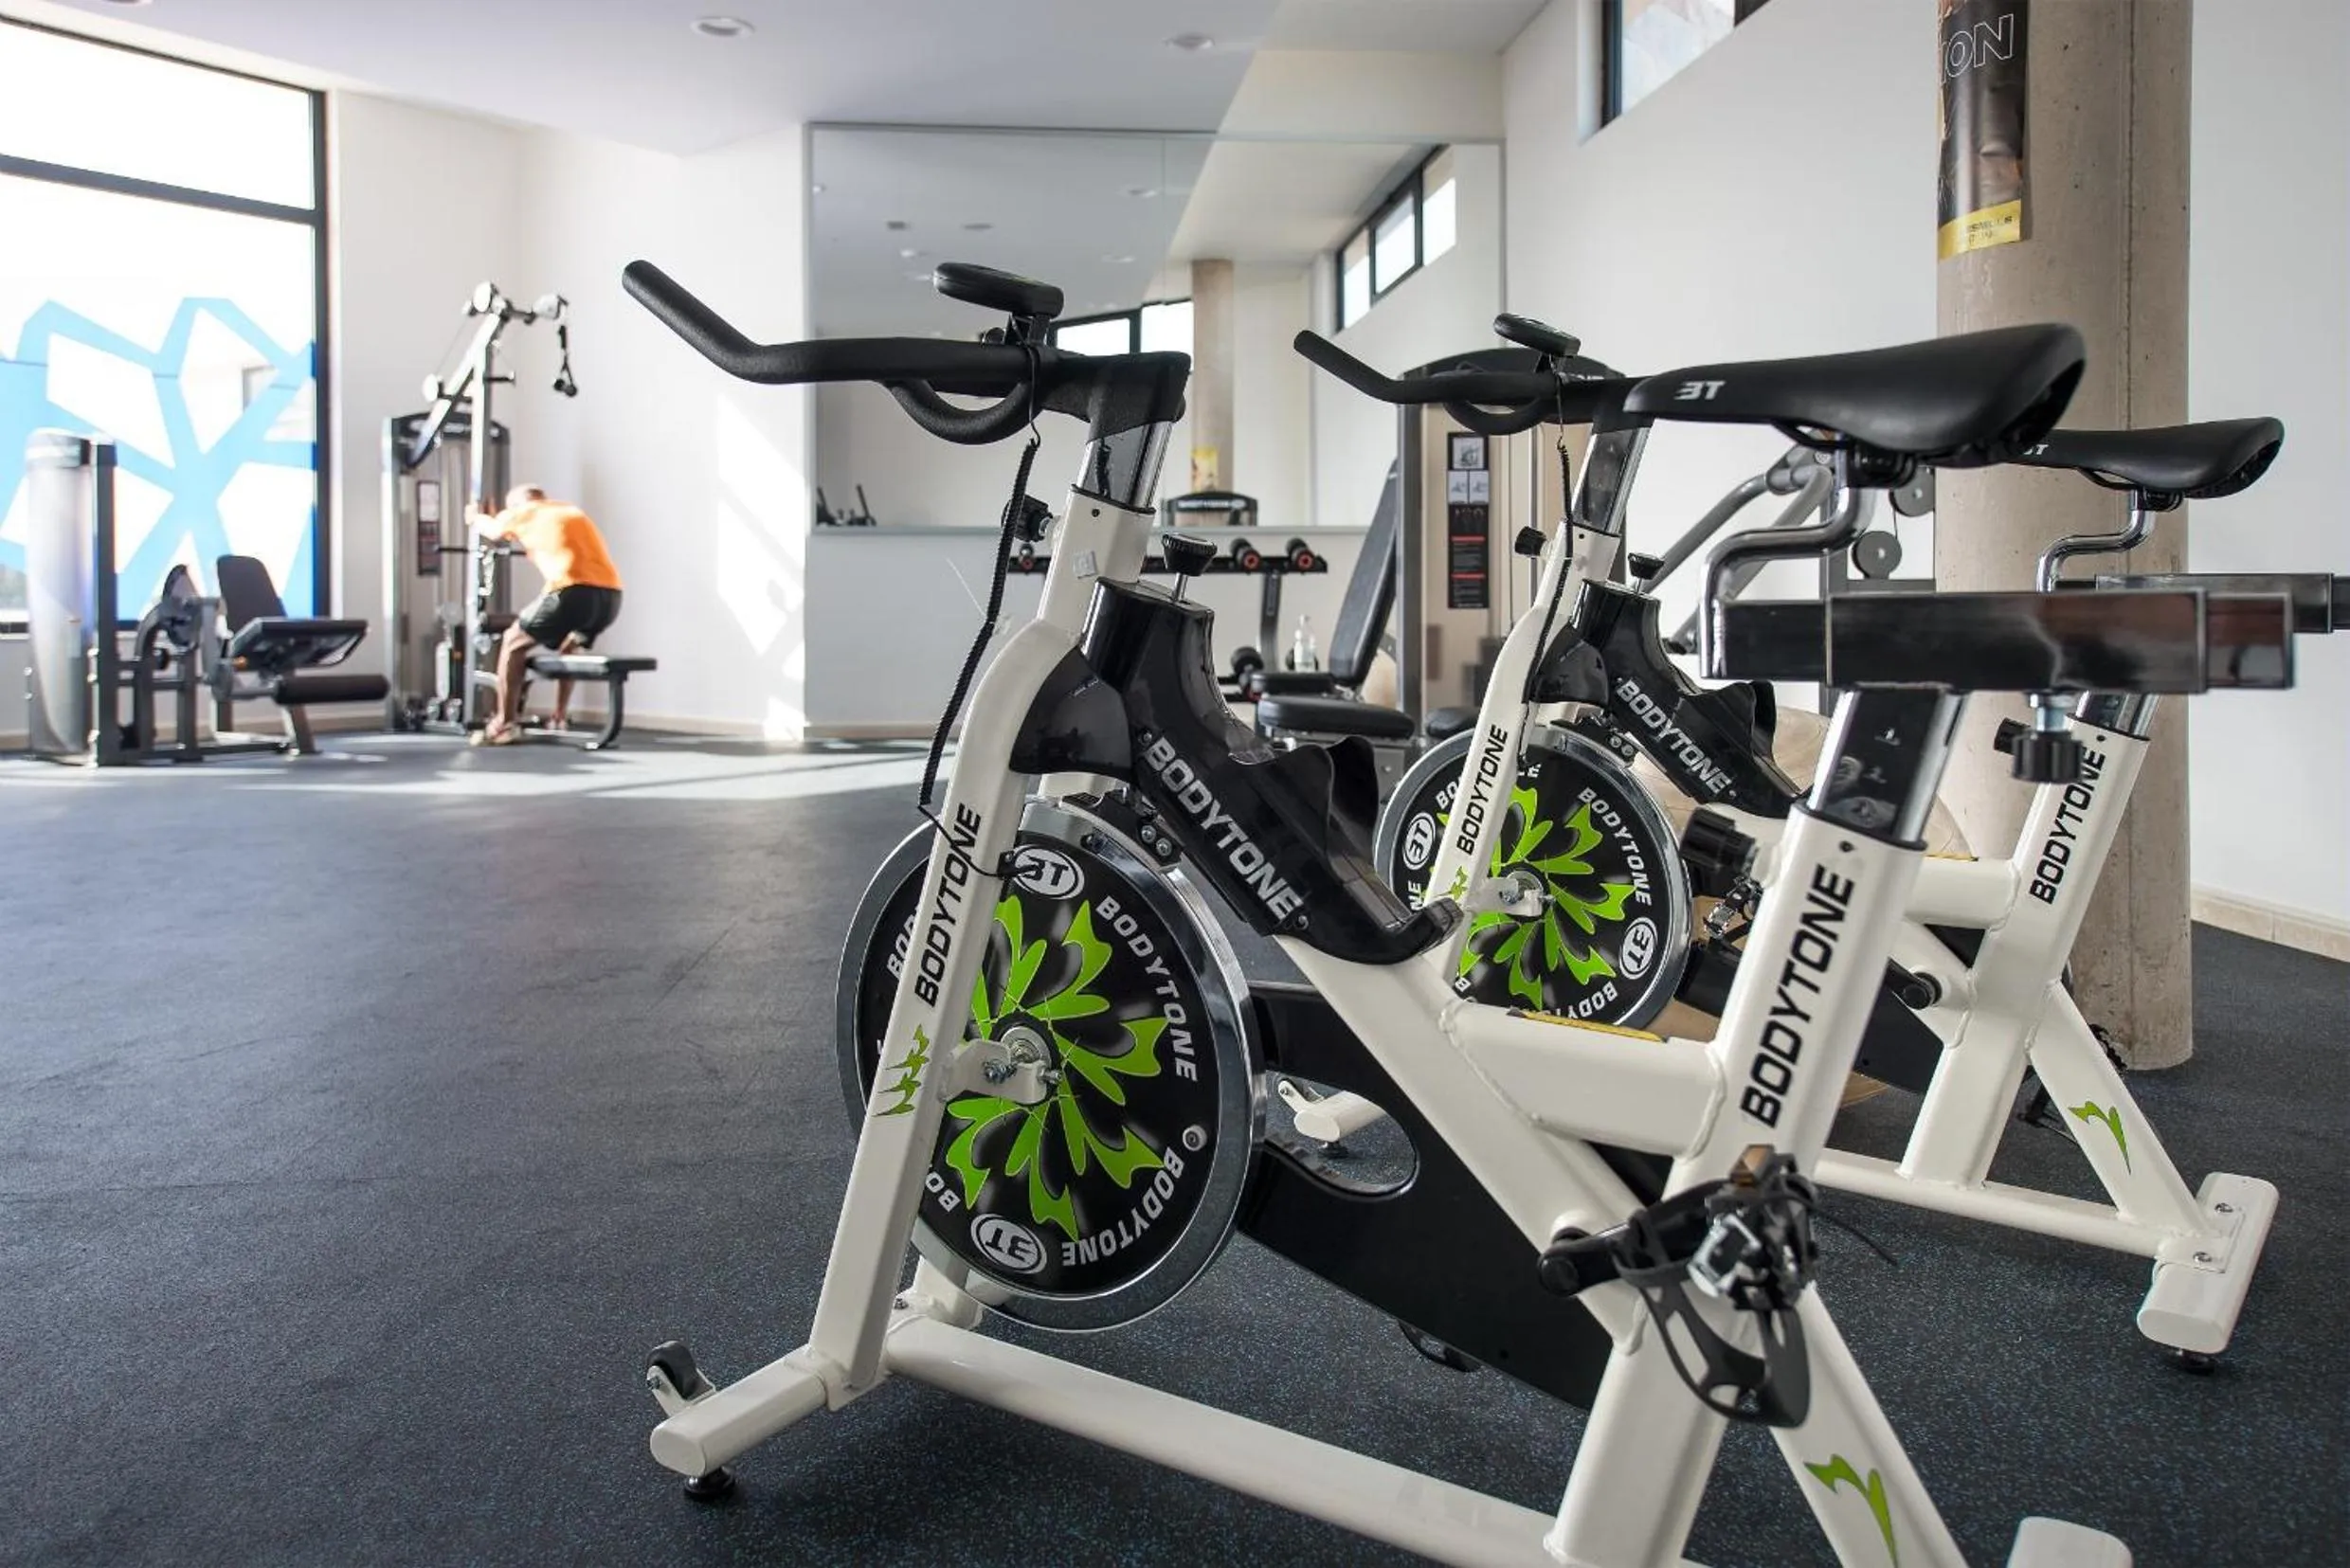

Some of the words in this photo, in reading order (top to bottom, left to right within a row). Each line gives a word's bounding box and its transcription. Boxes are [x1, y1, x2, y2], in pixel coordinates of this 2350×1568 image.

[1942, 13, 2014, 83] ON
[1673, 381, 1726, 400] 3T
[1456, 724, 1509, 856] BODYTONE
[1617, 678, 1732, 795] BODYTONE
[1145, 736, 1304, 921] BODYTONE
[1578, 787, 1653, 907] BODYTONE
[914, 803, 982, 1008] BODYTONE
[1095, 895, 1199, 1082] BODYTONE
[1740, 863, 1855, 1129] BODYTONE
[1061, 1146, 1184, 1267] BODYTONE
